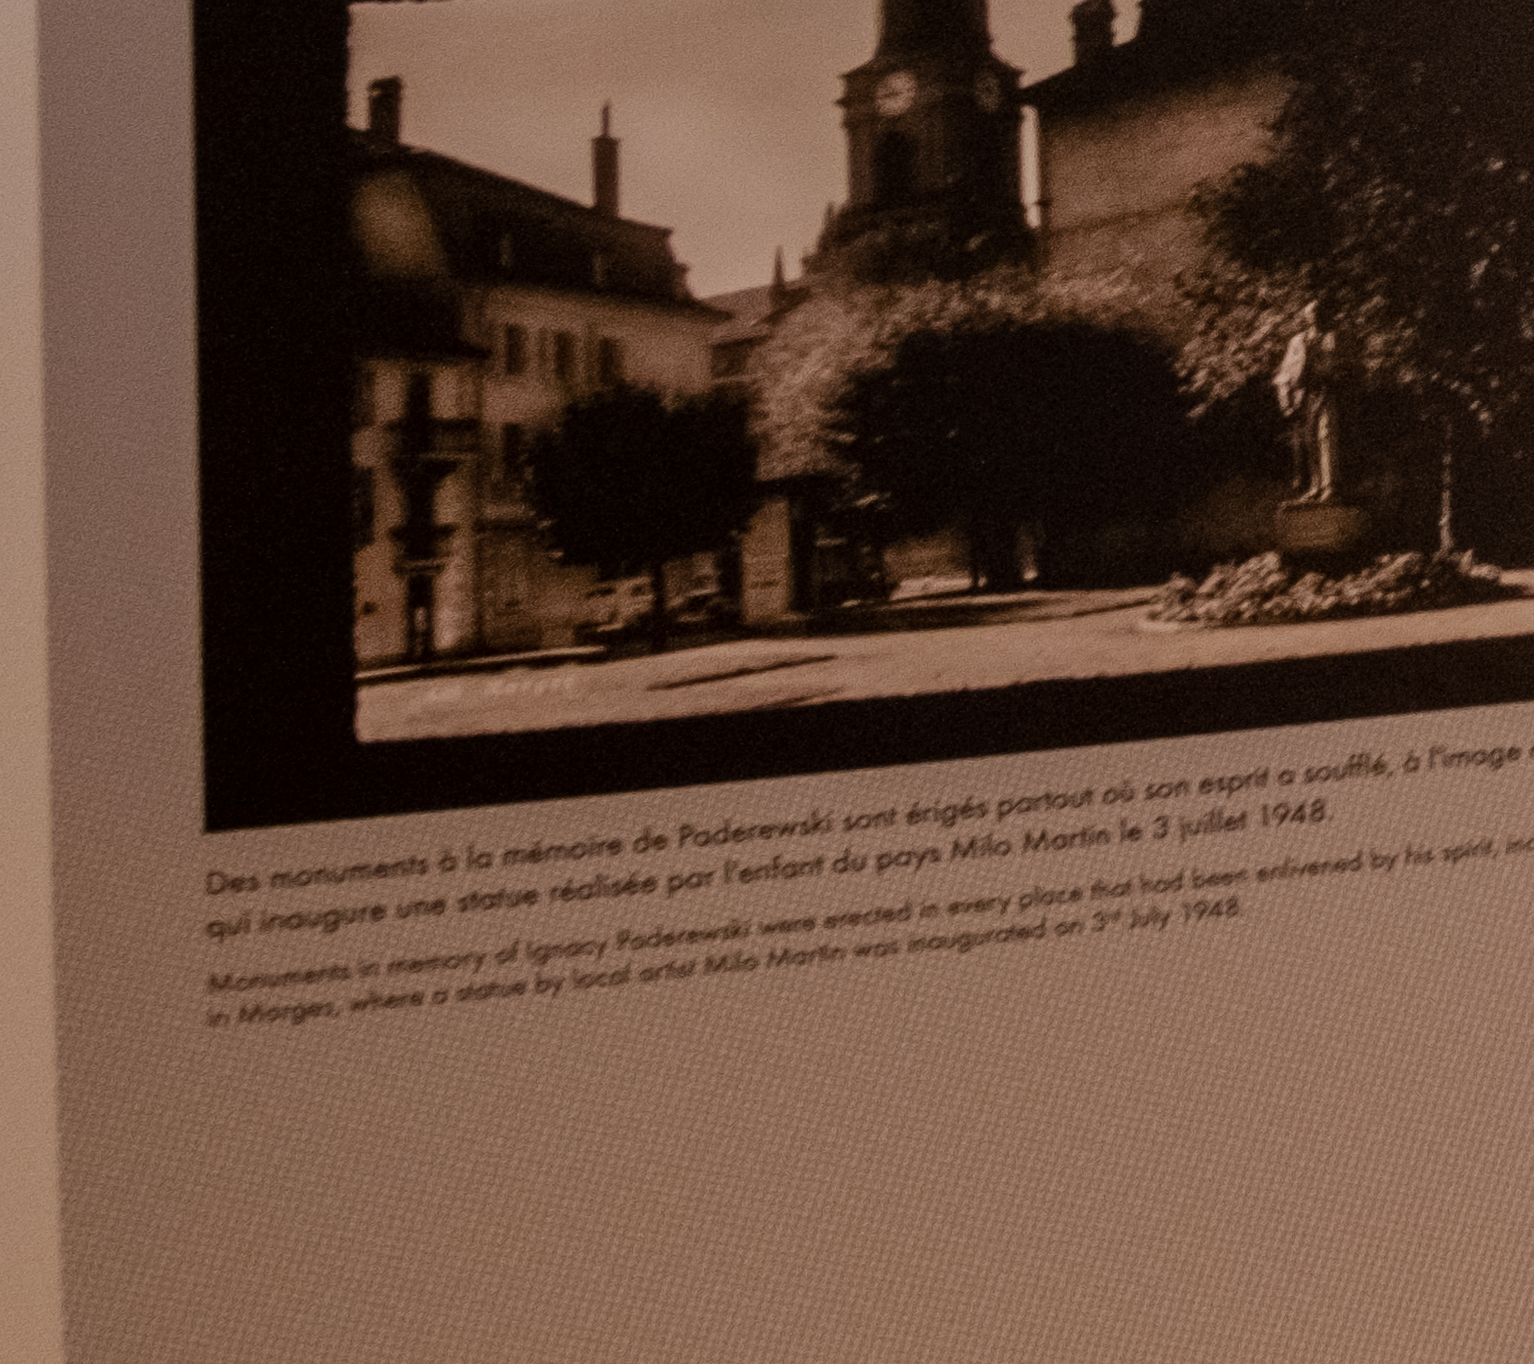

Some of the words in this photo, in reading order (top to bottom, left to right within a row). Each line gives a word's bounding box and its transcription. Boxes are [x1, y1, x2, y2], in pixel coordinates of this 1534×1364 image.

[205, 869, 261, 896] Des
[269, 855, 429, 888] monuments
[437, 849, 458, 874] à
[466, 844, 493, 870] la
[502, 836, 624, 866] mémoire
[632, 826, 670, 854] de
[678, 810, 833, 849] Paderewski
[842, 808, 898, 834] sont
[905, 796, 989, 829] érigés
[996, 787, 1095, 823] partout
[1101, 779, 1136, 805] où
[1144, 778, 1190, 801] son
[1197, 768, 1270, 799] esprit
[1276, 769, 1296, 787] a
[1402, 751, 1421, 774] à
[1428, 745, 1522, 771] l'image
